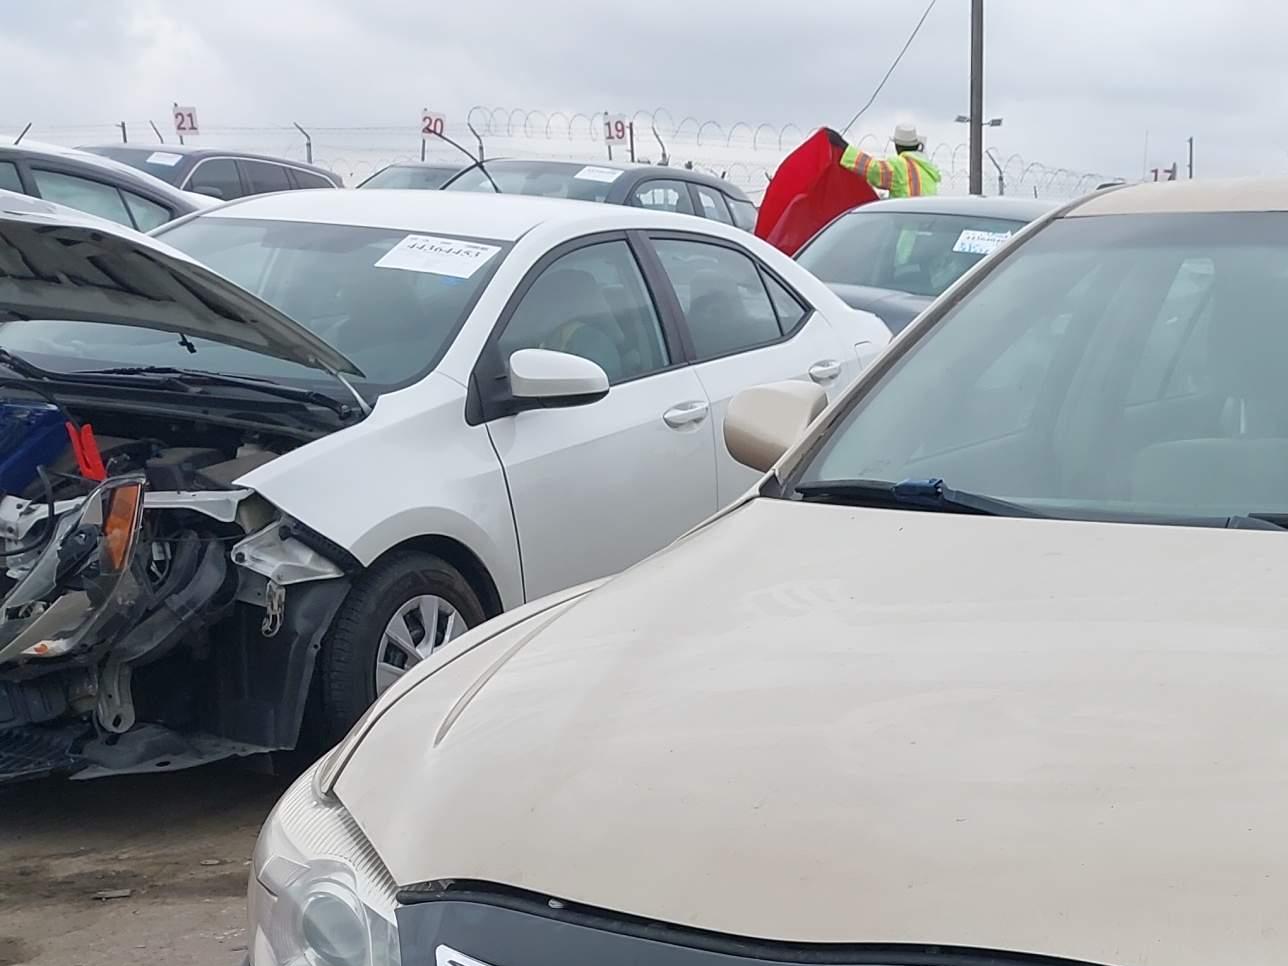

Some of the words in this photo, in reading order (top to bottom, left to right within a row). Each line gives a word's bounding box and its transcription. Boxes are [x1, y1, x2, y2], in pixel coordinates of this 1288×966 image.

[175, 112, 198, 130] 21
[422, 116, 444, 136] 20
[604, 120, 625, 140] 19
